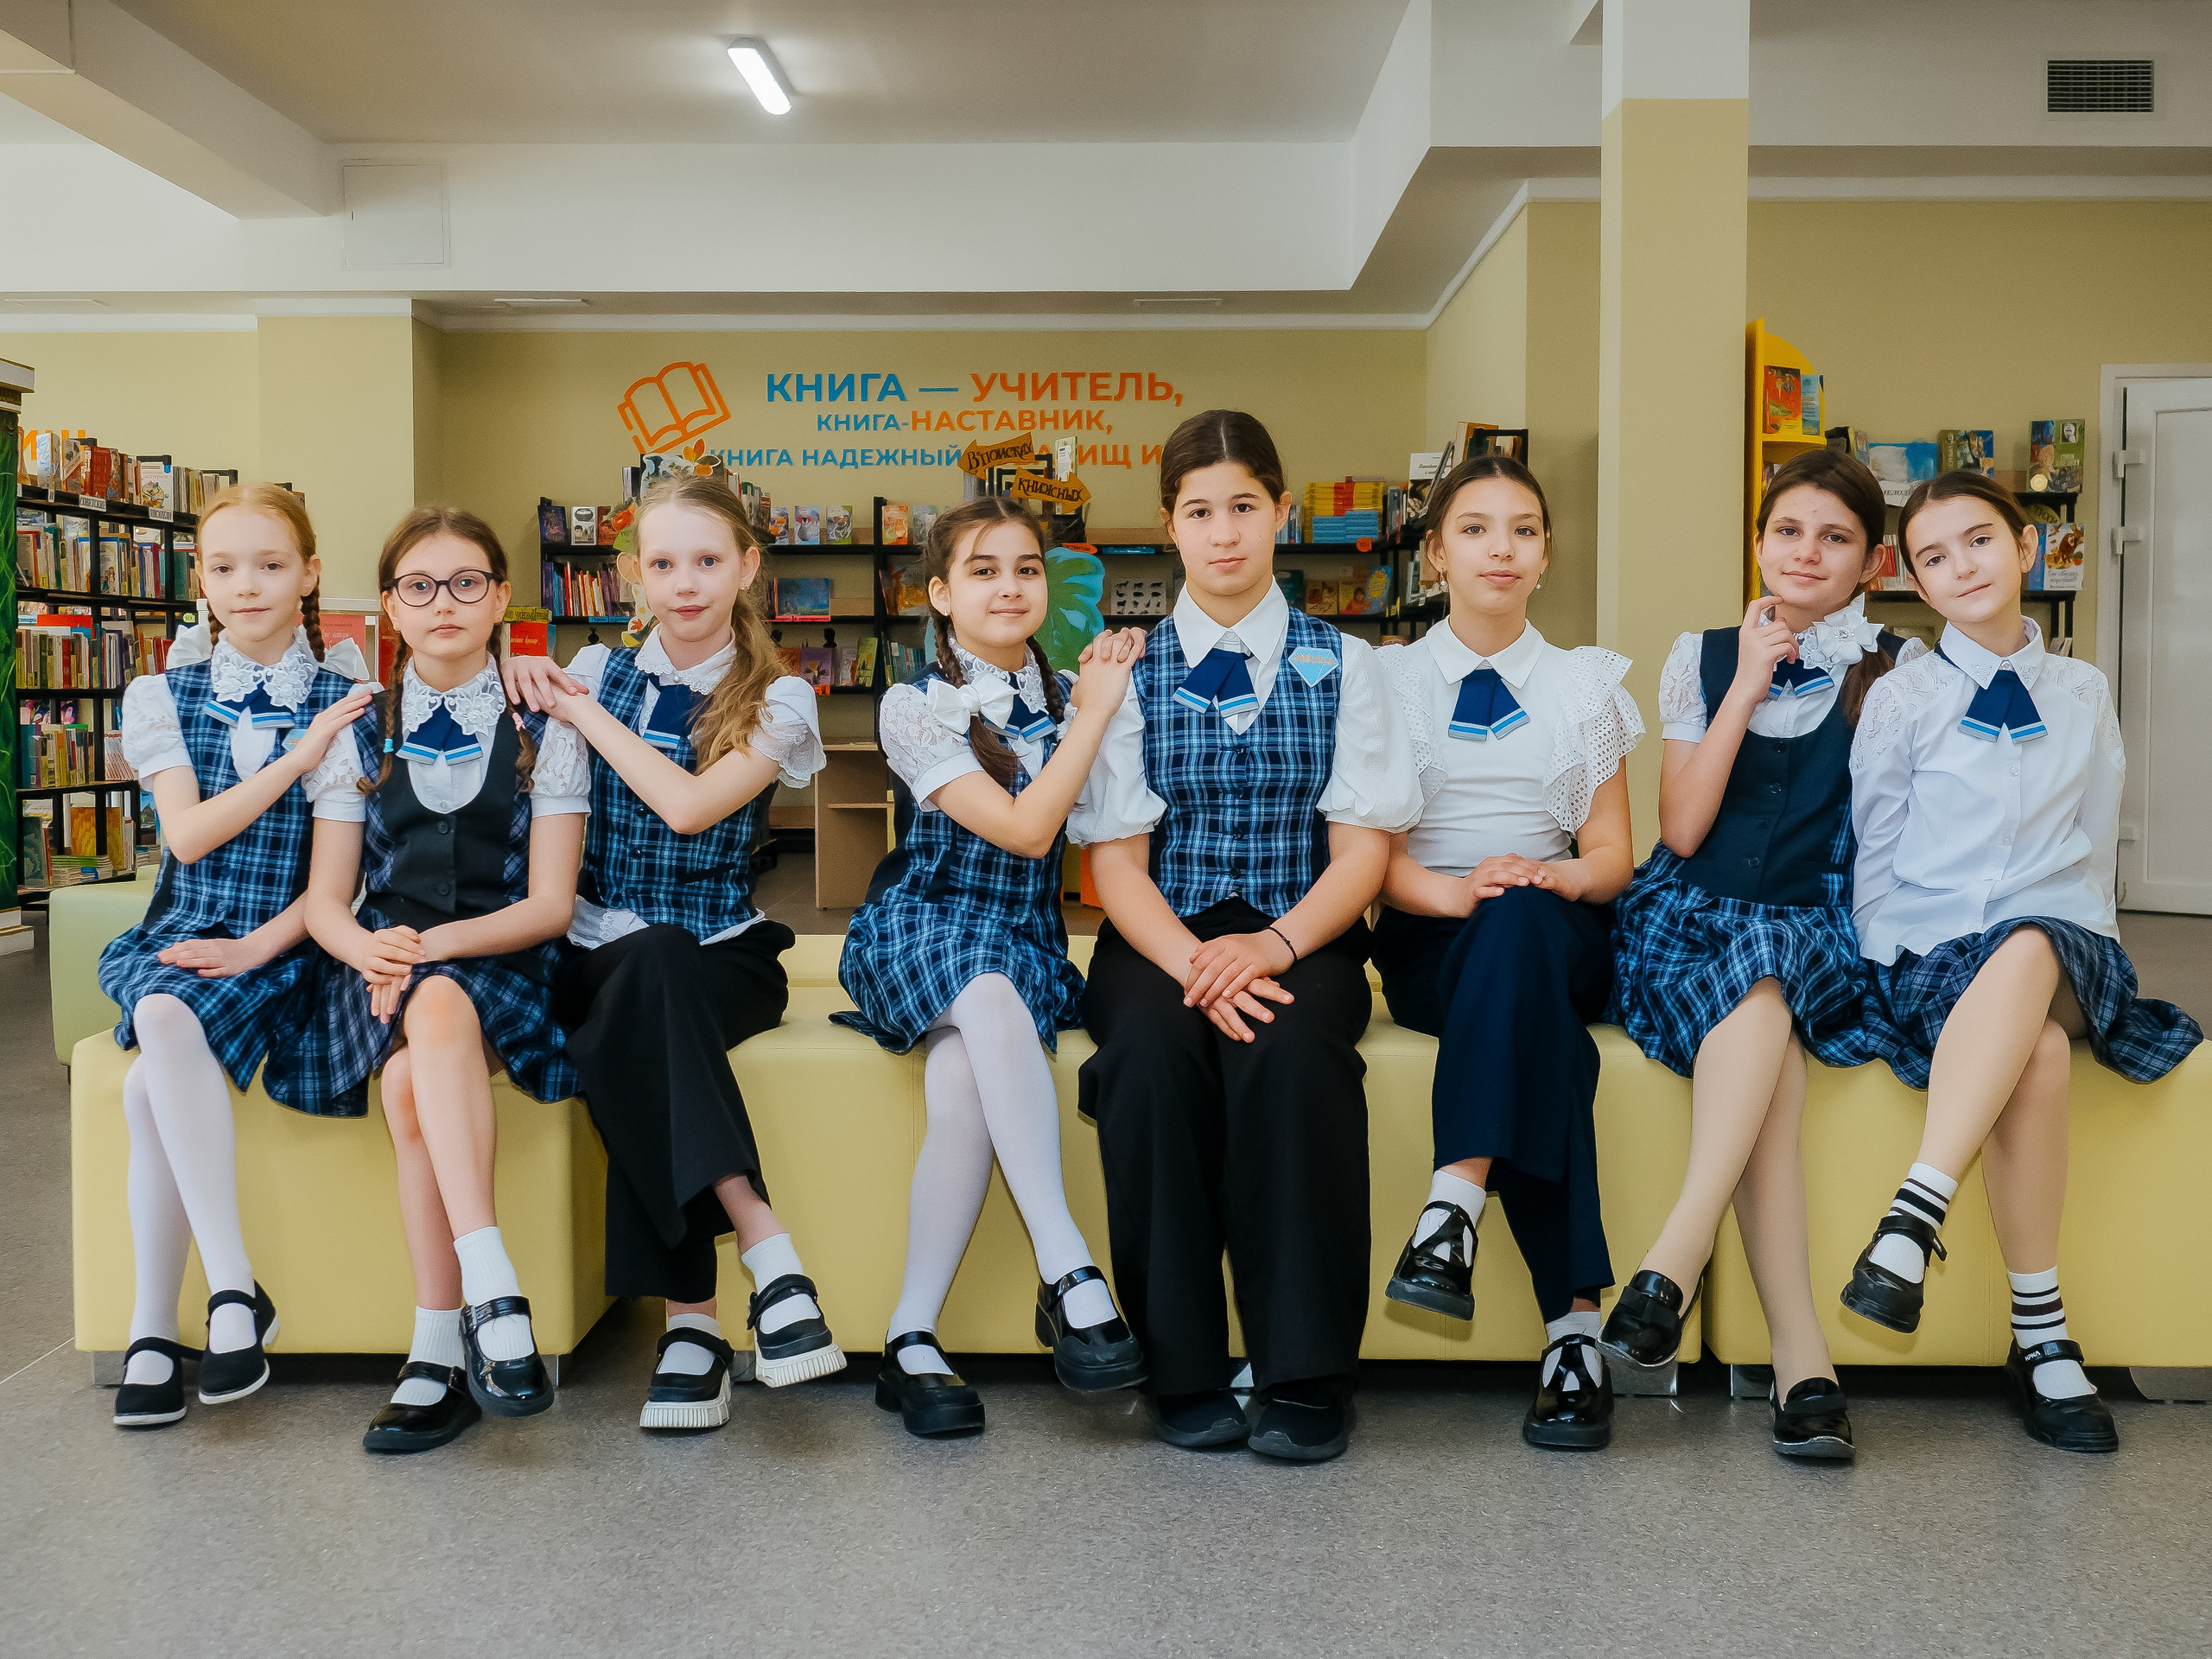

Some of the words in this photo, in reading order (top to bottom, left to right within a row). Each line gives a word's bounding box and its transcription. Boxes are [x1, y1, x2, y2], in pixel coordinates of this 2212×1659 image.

[766, 373, 907, 403] КНИГА
[969, 372, 1184, 407] УЧИТЕЛЬ,
[817, 409, 1113, 435] КНИГА-НАСТАВНИК,
[802, 444, 962, 469] НАДЕЖНЫЙ
